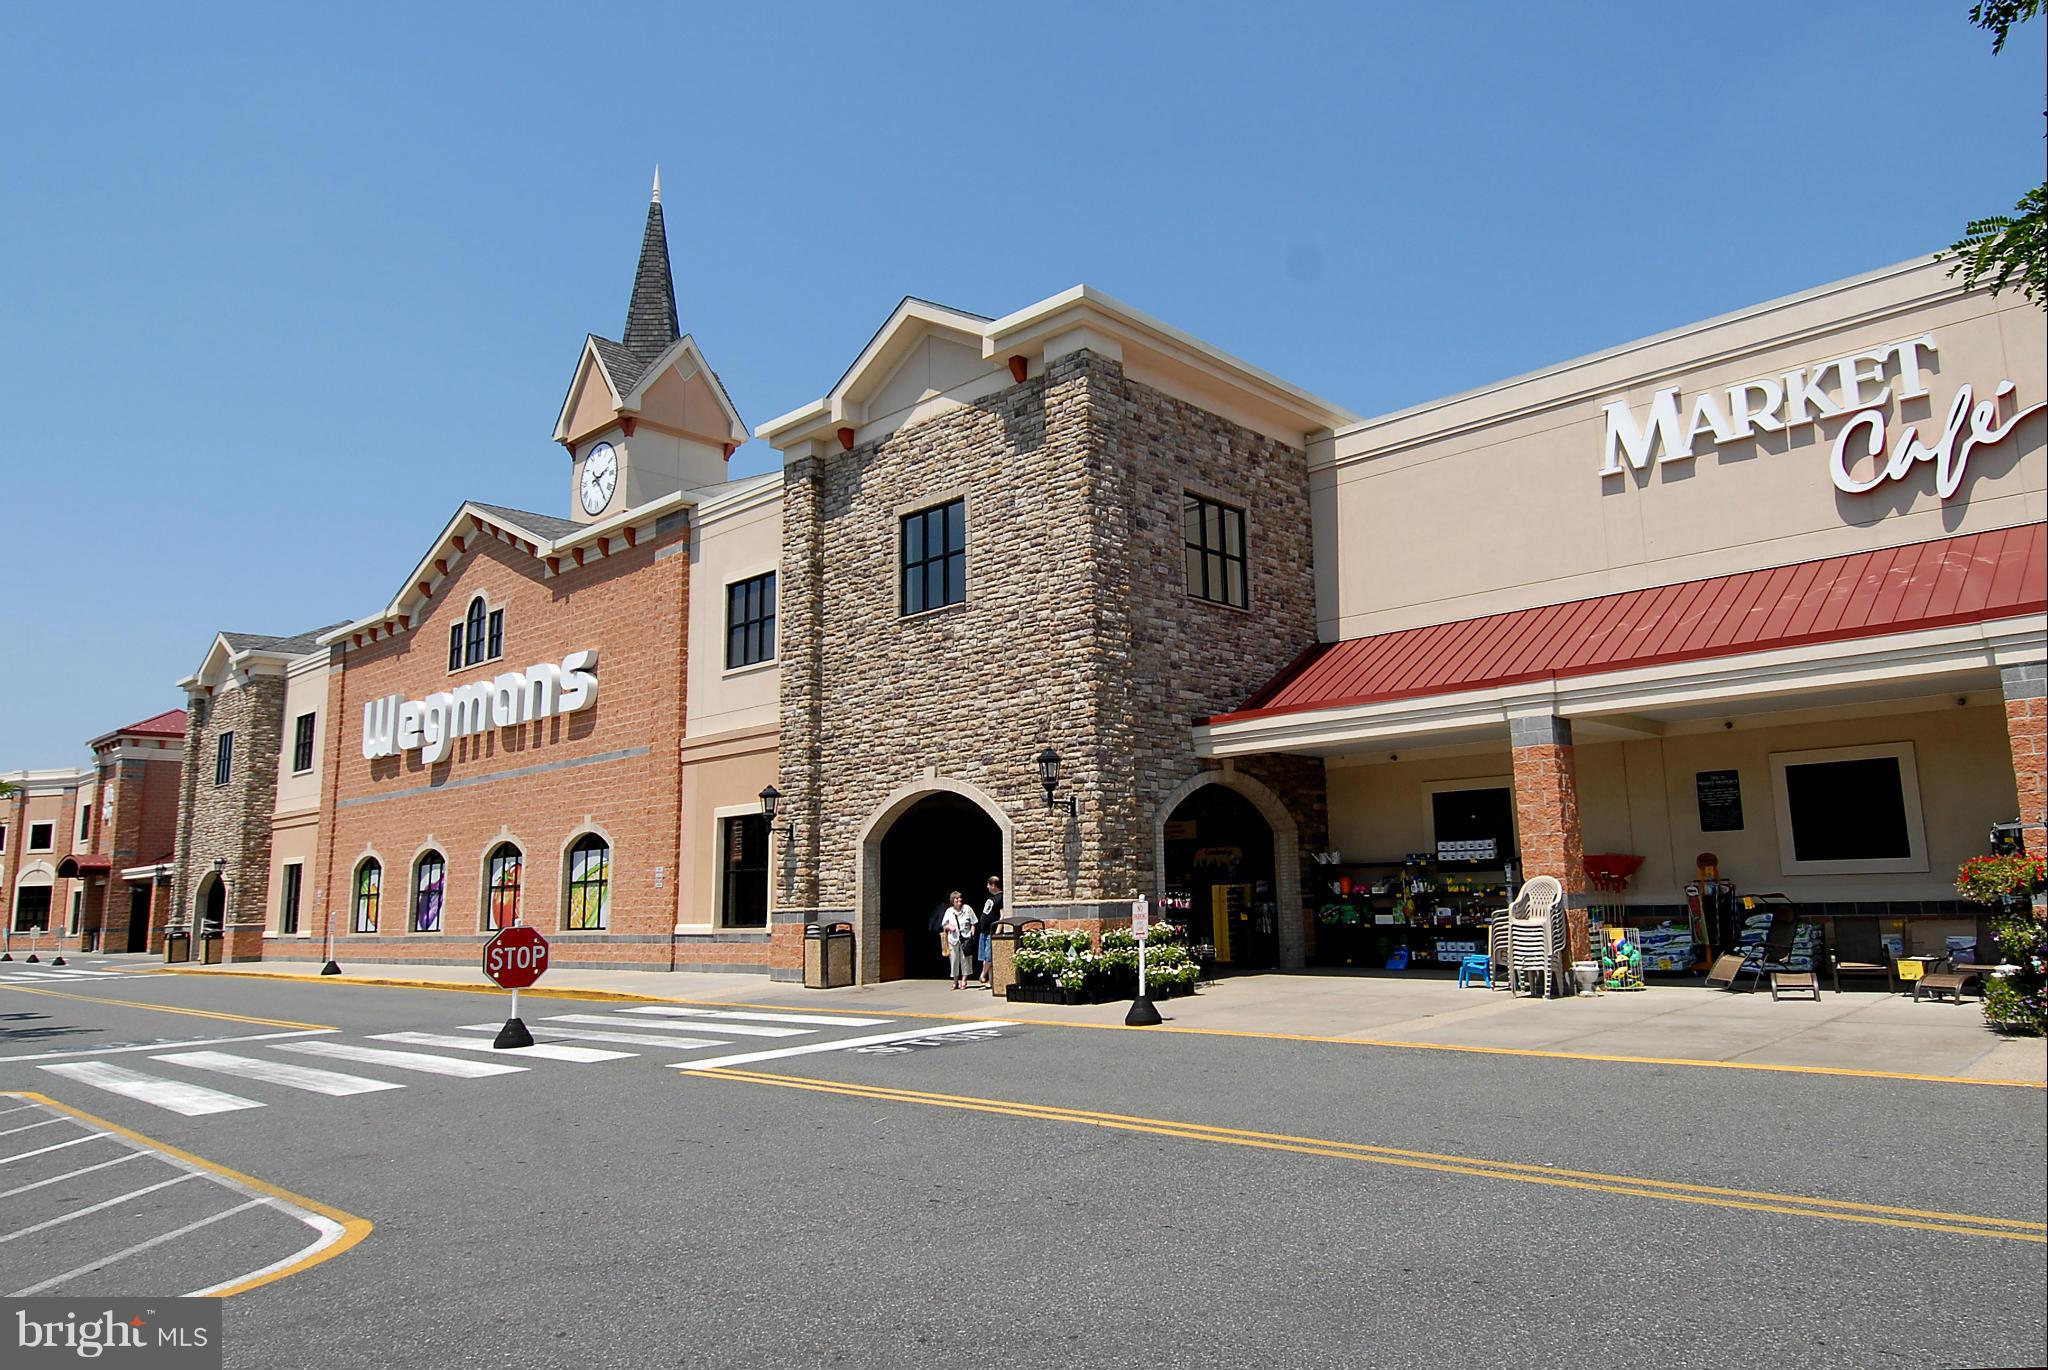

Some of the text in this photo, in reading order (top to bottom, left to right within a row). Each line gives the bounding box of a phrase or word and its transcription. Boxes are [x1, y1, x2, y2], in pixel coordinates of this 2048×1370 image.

[1599, 333, 1936, 476] MARKET
[1830, 379, 2047, 498] Café
[362, 650, 598, 764] Wegmans
[490, 945, 546, 970] STOP
